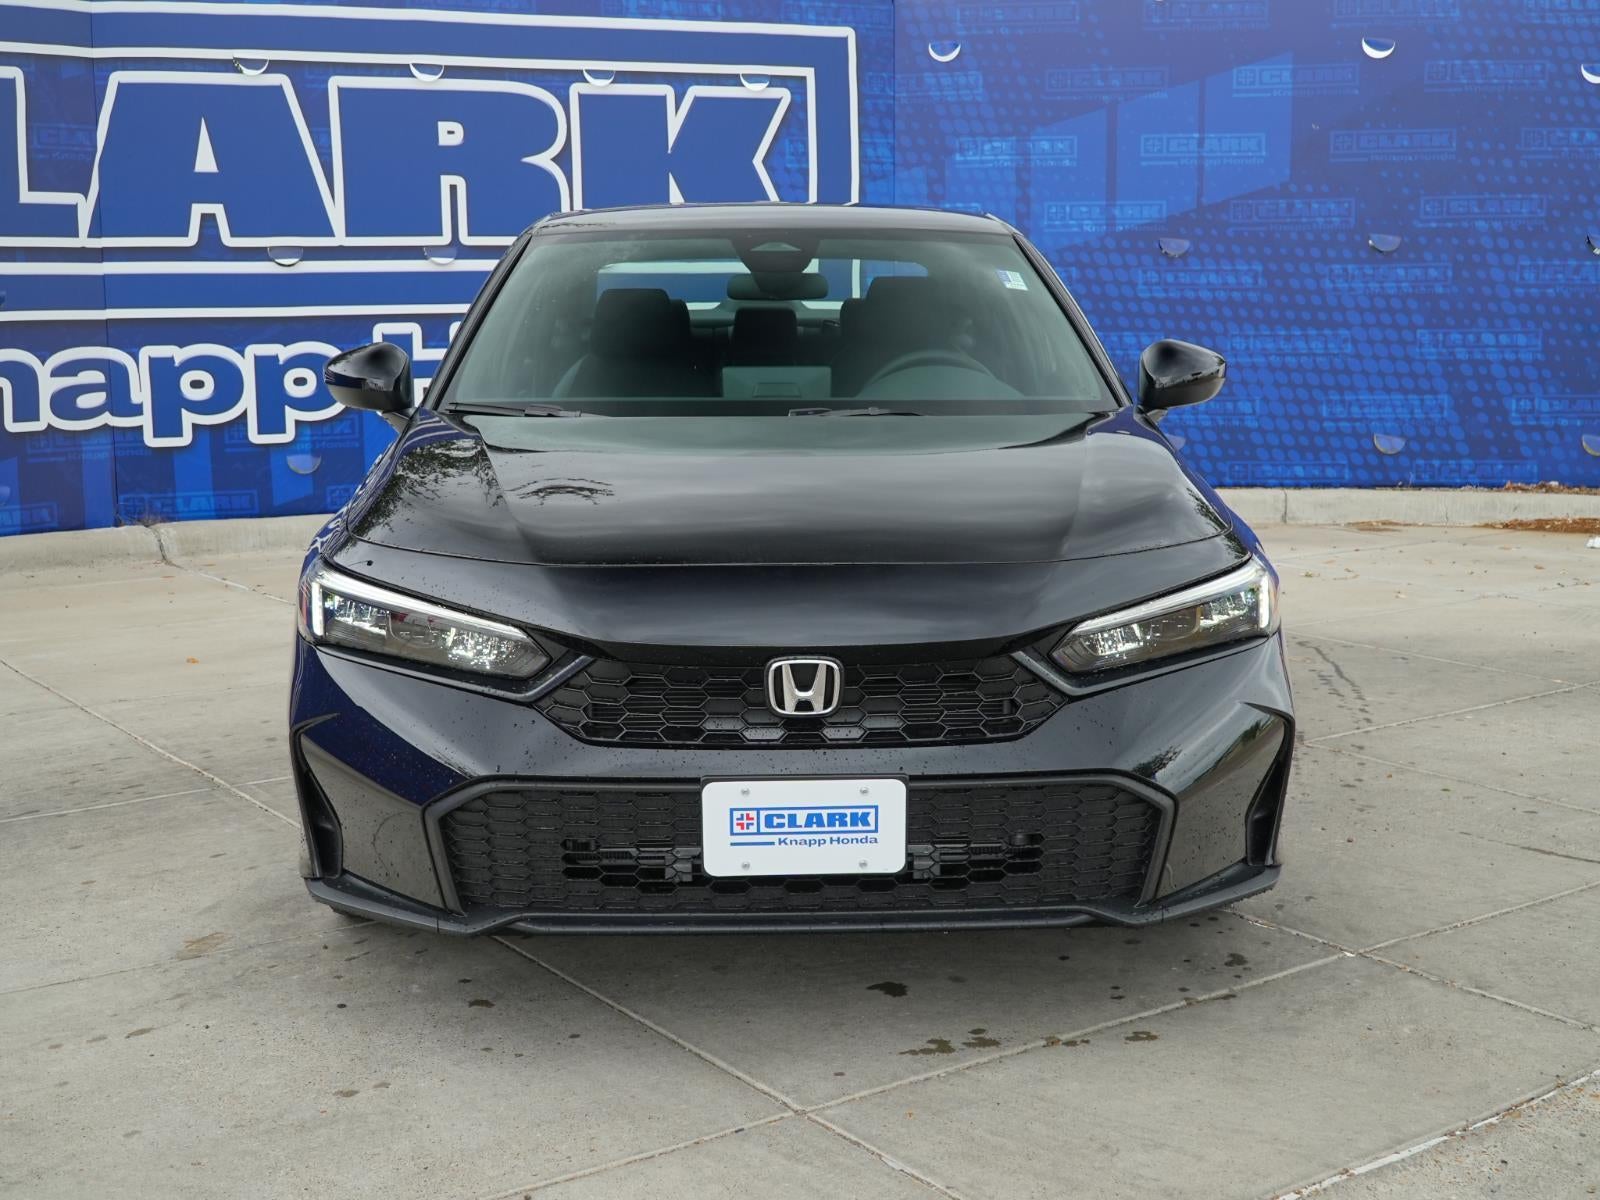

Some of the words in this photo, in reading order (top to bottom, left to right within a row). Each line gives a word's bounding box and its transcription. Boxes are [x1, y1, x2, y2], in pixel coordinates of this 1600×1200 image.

[764, 811, 872, 829] CLARK
[778, 837, 827, 848] Knapp
[829, 835, 879, 845] Honda
